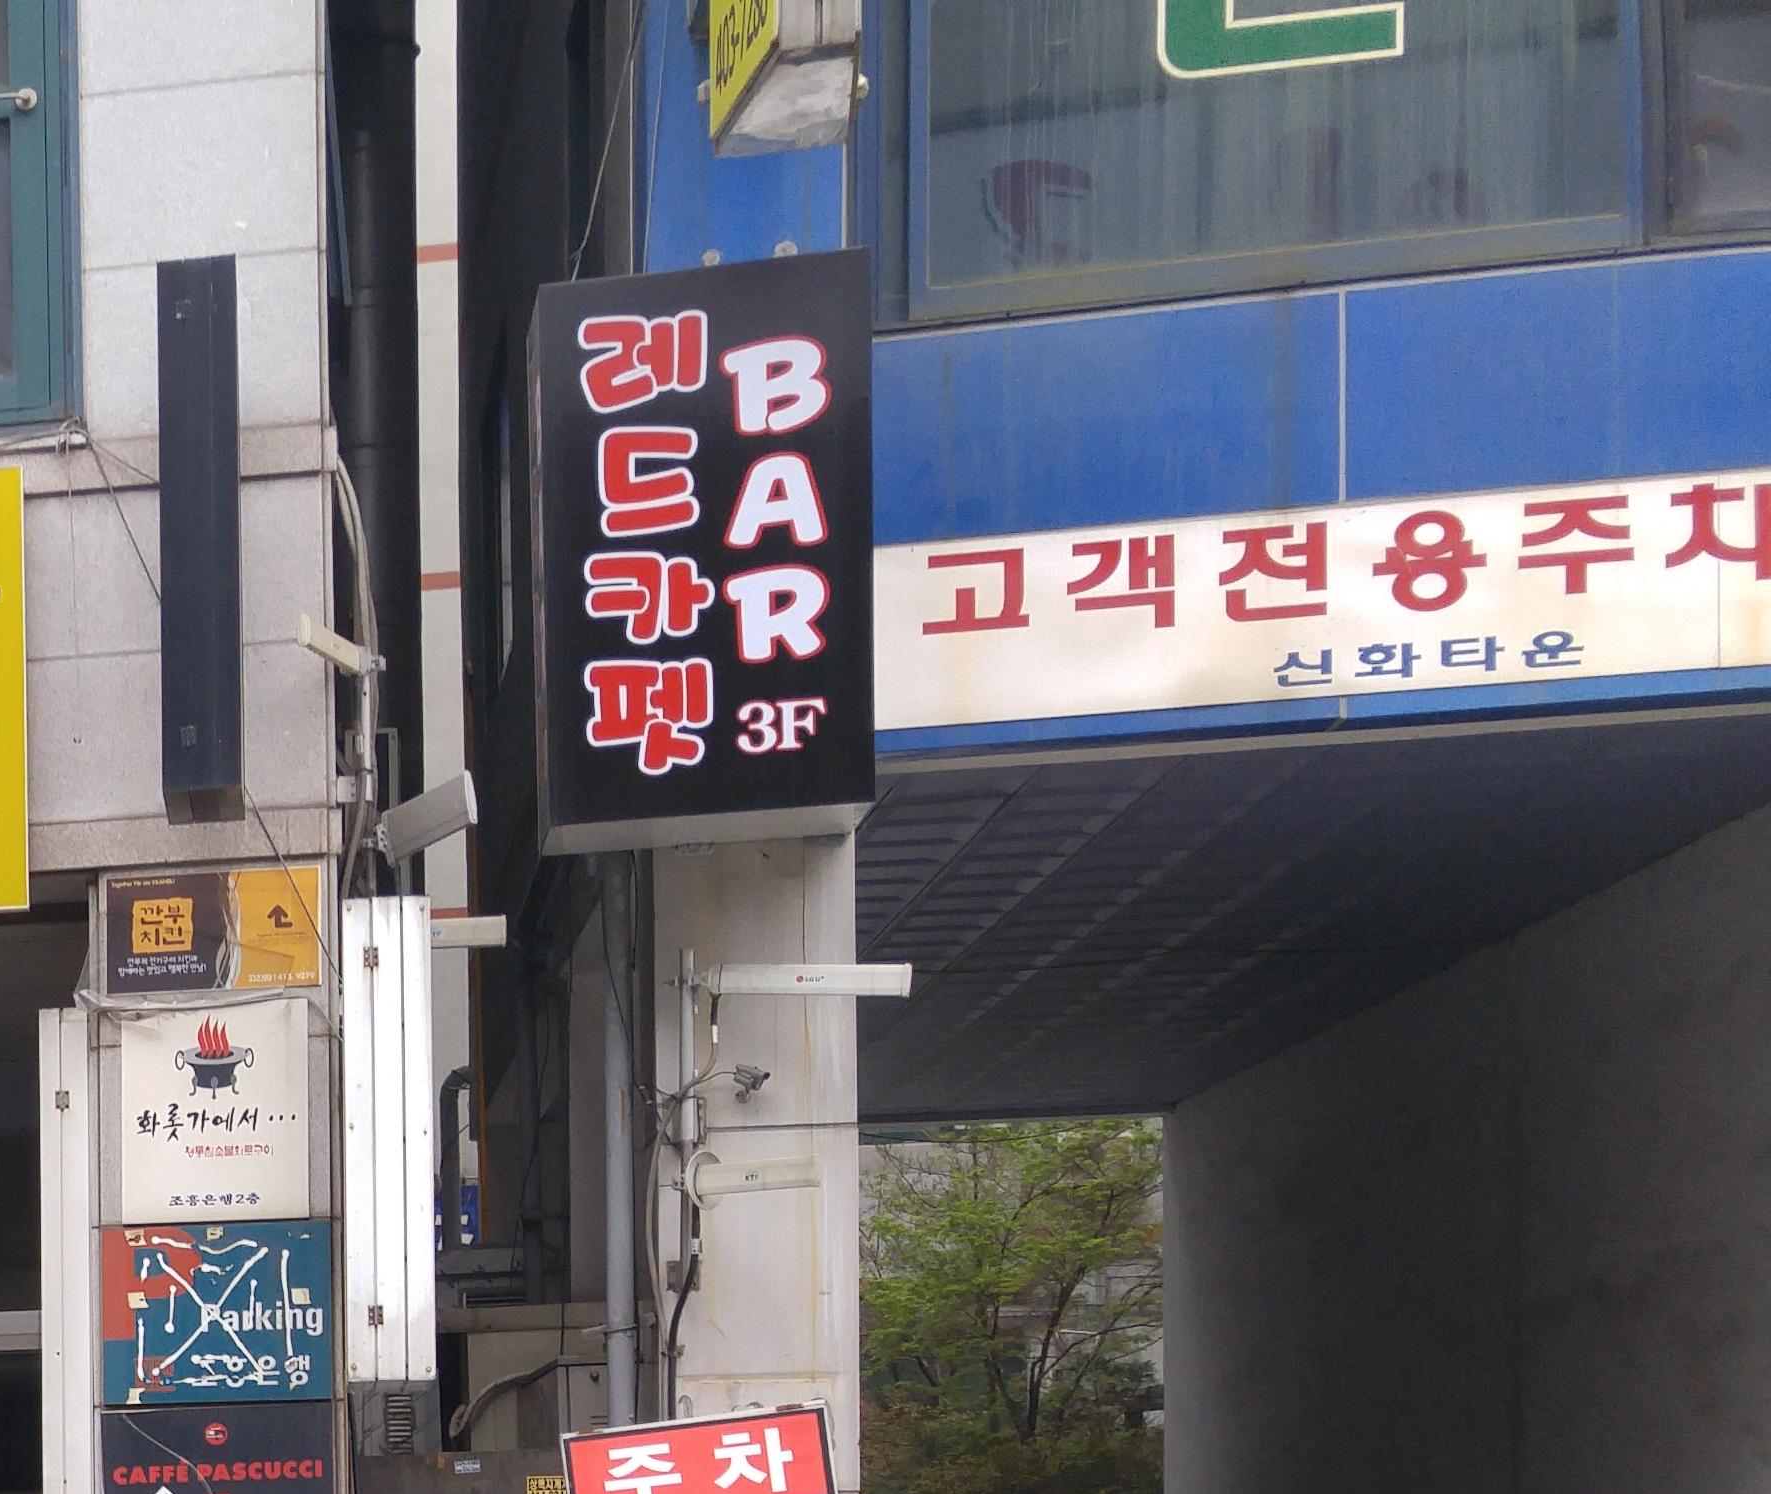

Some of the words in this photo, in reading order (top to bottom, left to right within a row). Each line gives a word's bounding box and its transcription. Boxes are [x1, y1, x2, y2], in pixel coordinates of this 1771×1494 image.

[718, 335, 832, 666] BAR
[577, 308, 713, 774] 레드카펫
[1274, 629, 1585, 689] 신화타운
[738, 699, 826, 753] 3F
[140, 905, 185, 926] 깐부
[140, 926, 185, 946] 치킨
[200, 1302, 324, 1336] Parking
[196, 1459, 324, 1482] PASCUCCI
